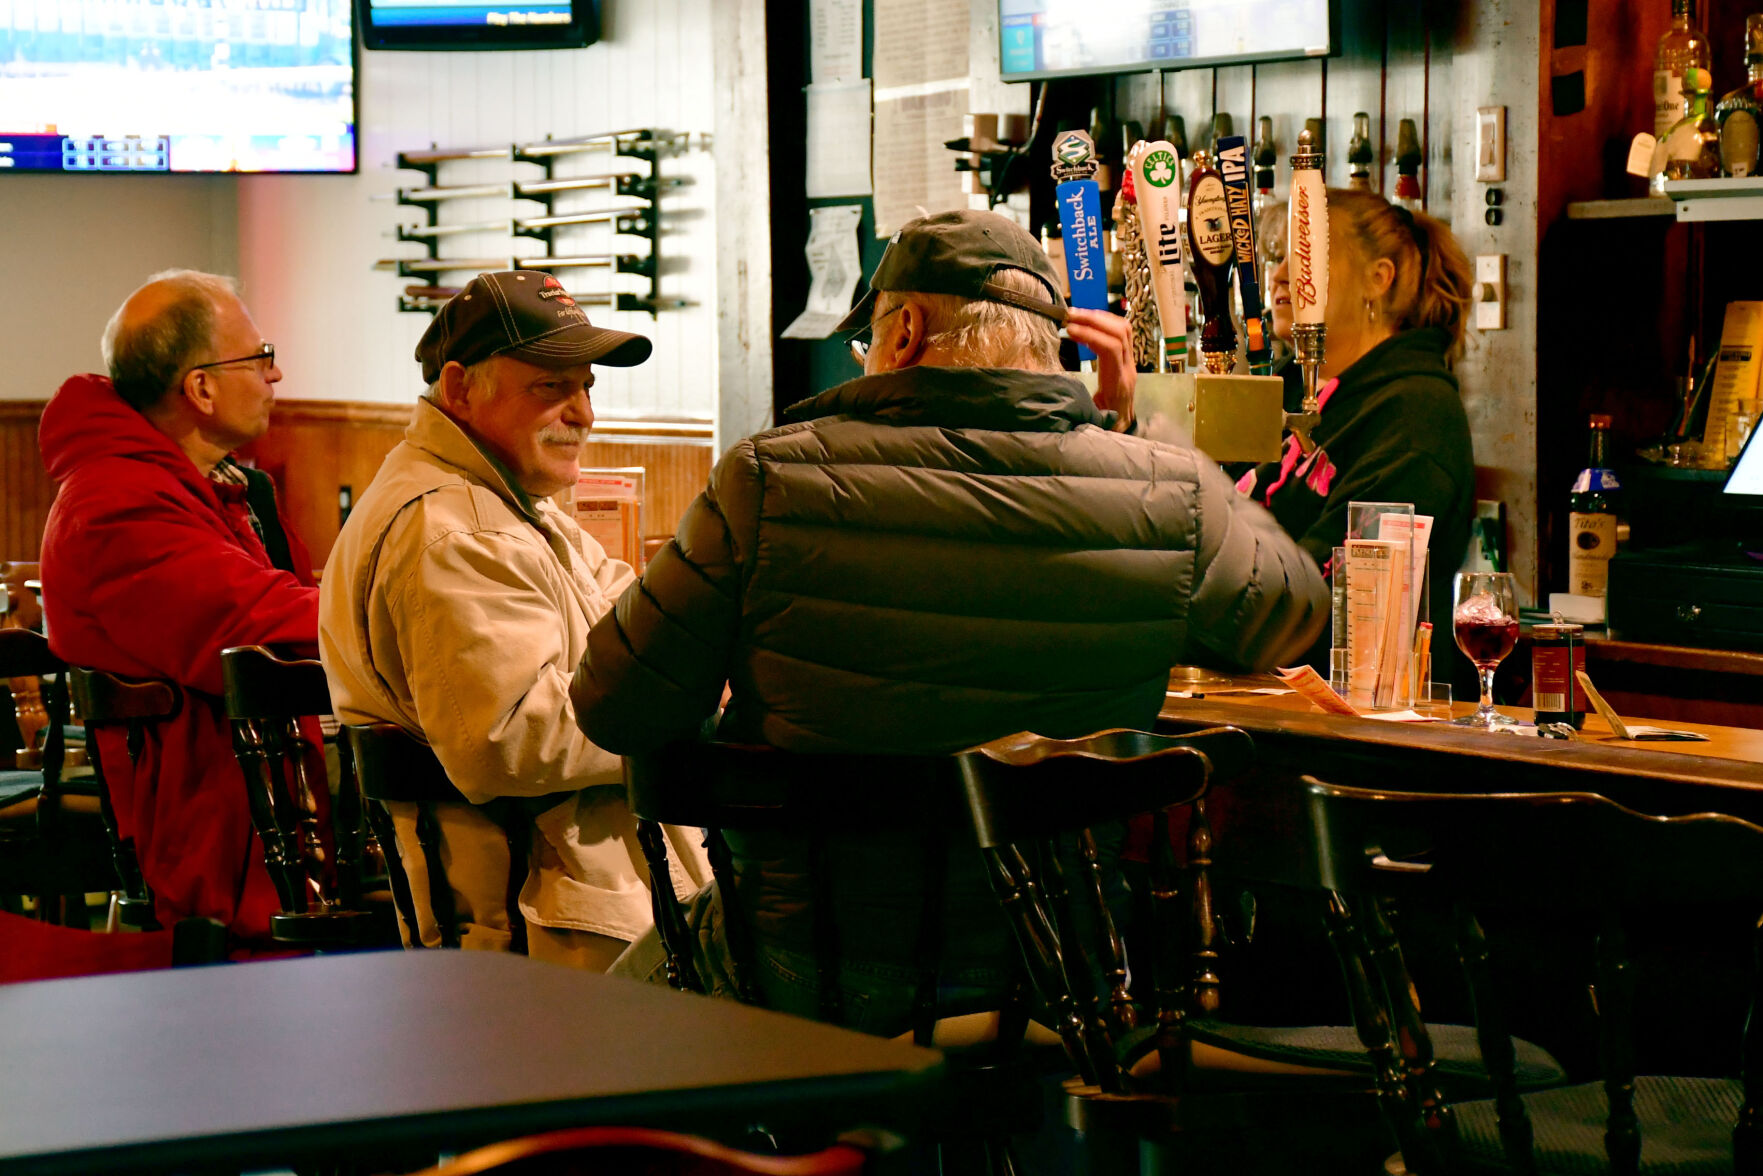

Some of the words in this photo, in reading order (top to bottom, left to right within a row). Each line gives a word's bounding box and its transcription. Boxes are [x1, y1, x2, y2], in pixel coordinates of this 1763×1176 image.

[1144, 151, 1175, 169] CELTICS
[1219, 146, 1246, 182] IPA
[1225, 185, 1248, 216] HAZY
[1066, 186, 1094, 281] Switchback
[1087, 215, 1099, 249] ALE
[1159, 223, 1181, 266] Lite
[1199, 232, 1232, 245] LAGER
[1295, 185, 1317, 310] Budweiser
[1574, 518, 1605, 529] Tito's
